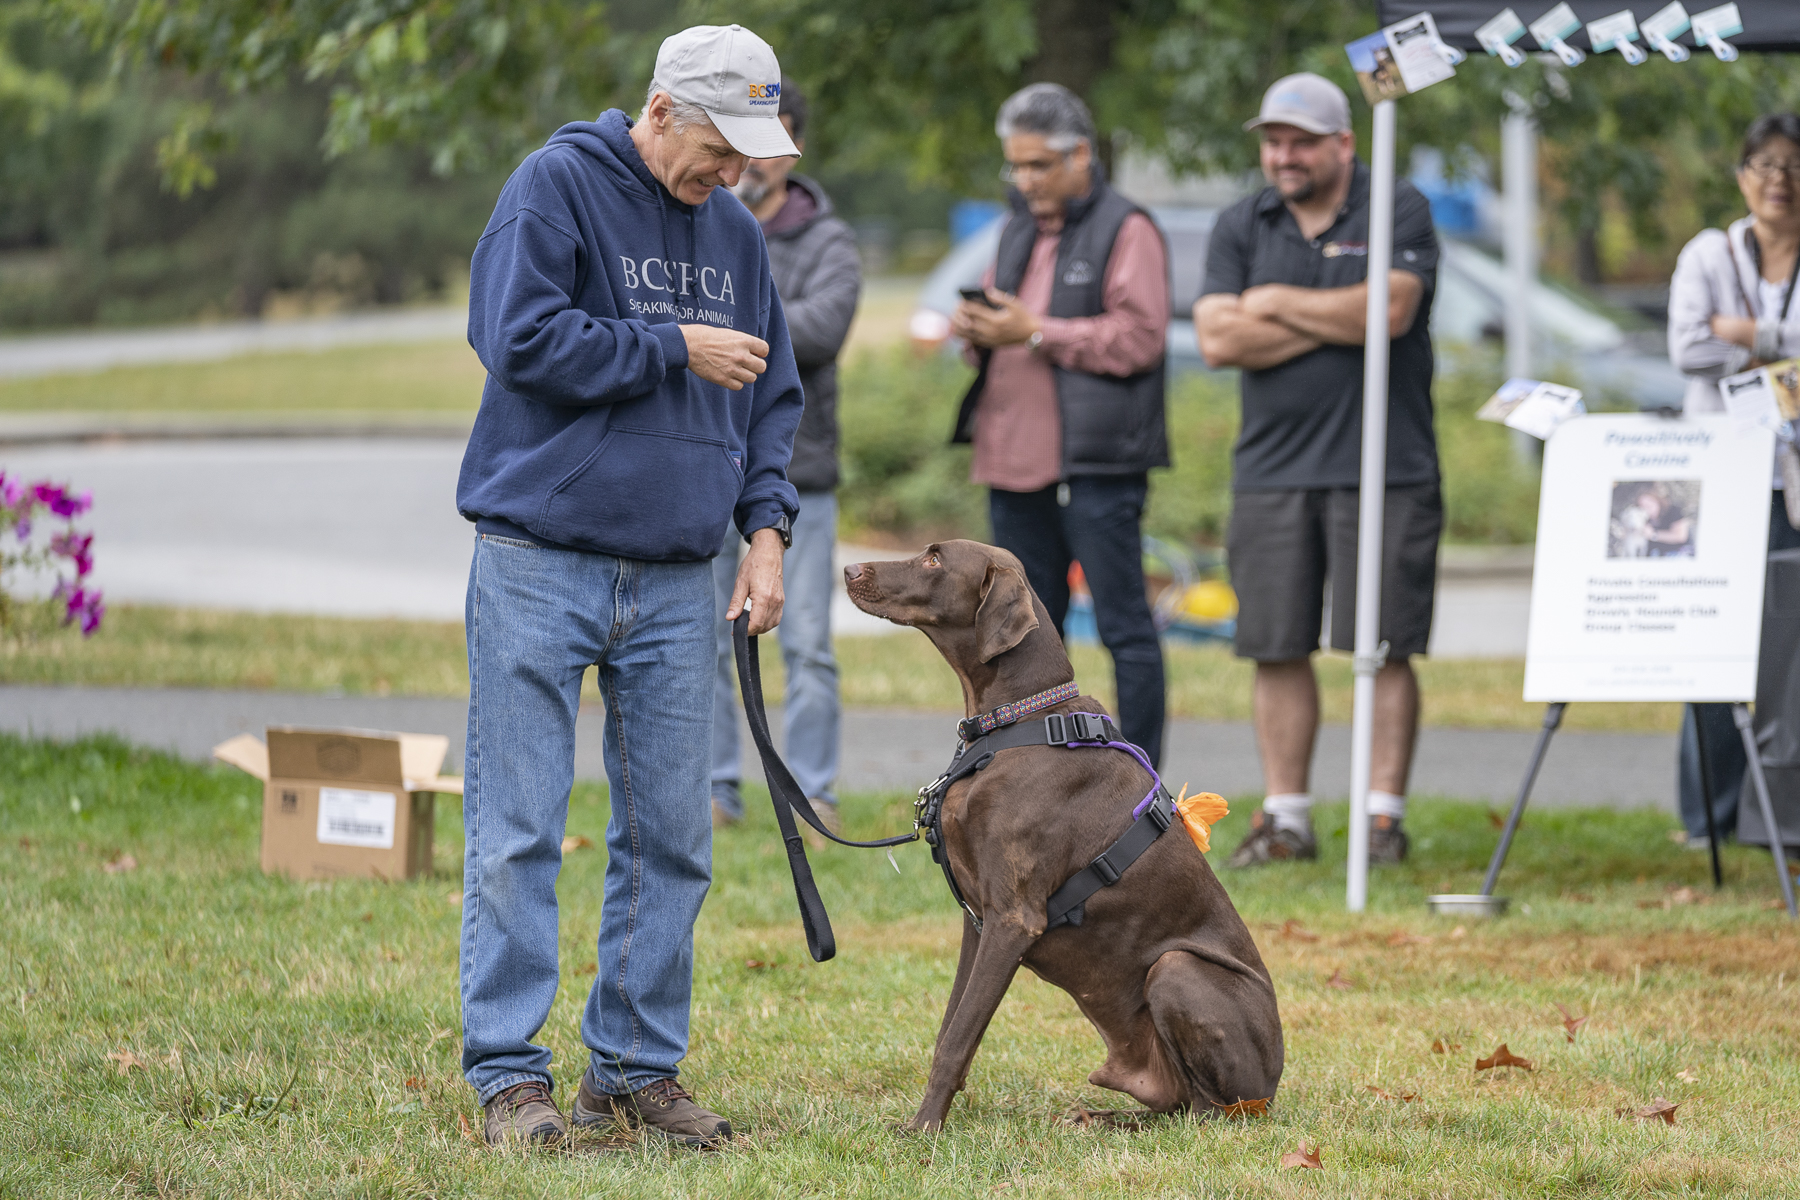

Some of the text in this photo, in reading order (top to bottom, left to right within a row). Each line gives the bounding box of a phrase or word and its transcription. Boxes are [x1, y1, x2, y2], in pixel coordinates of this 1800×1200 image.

[748, 82, 781, 98] BCSP
[629, 298, 675, 316] SEAKING
[696, 308, 734, 329] ANIMALS
[1624, 450, 1691, 468] Canine
[1587, 575, 1730, 587] Private Consultations
